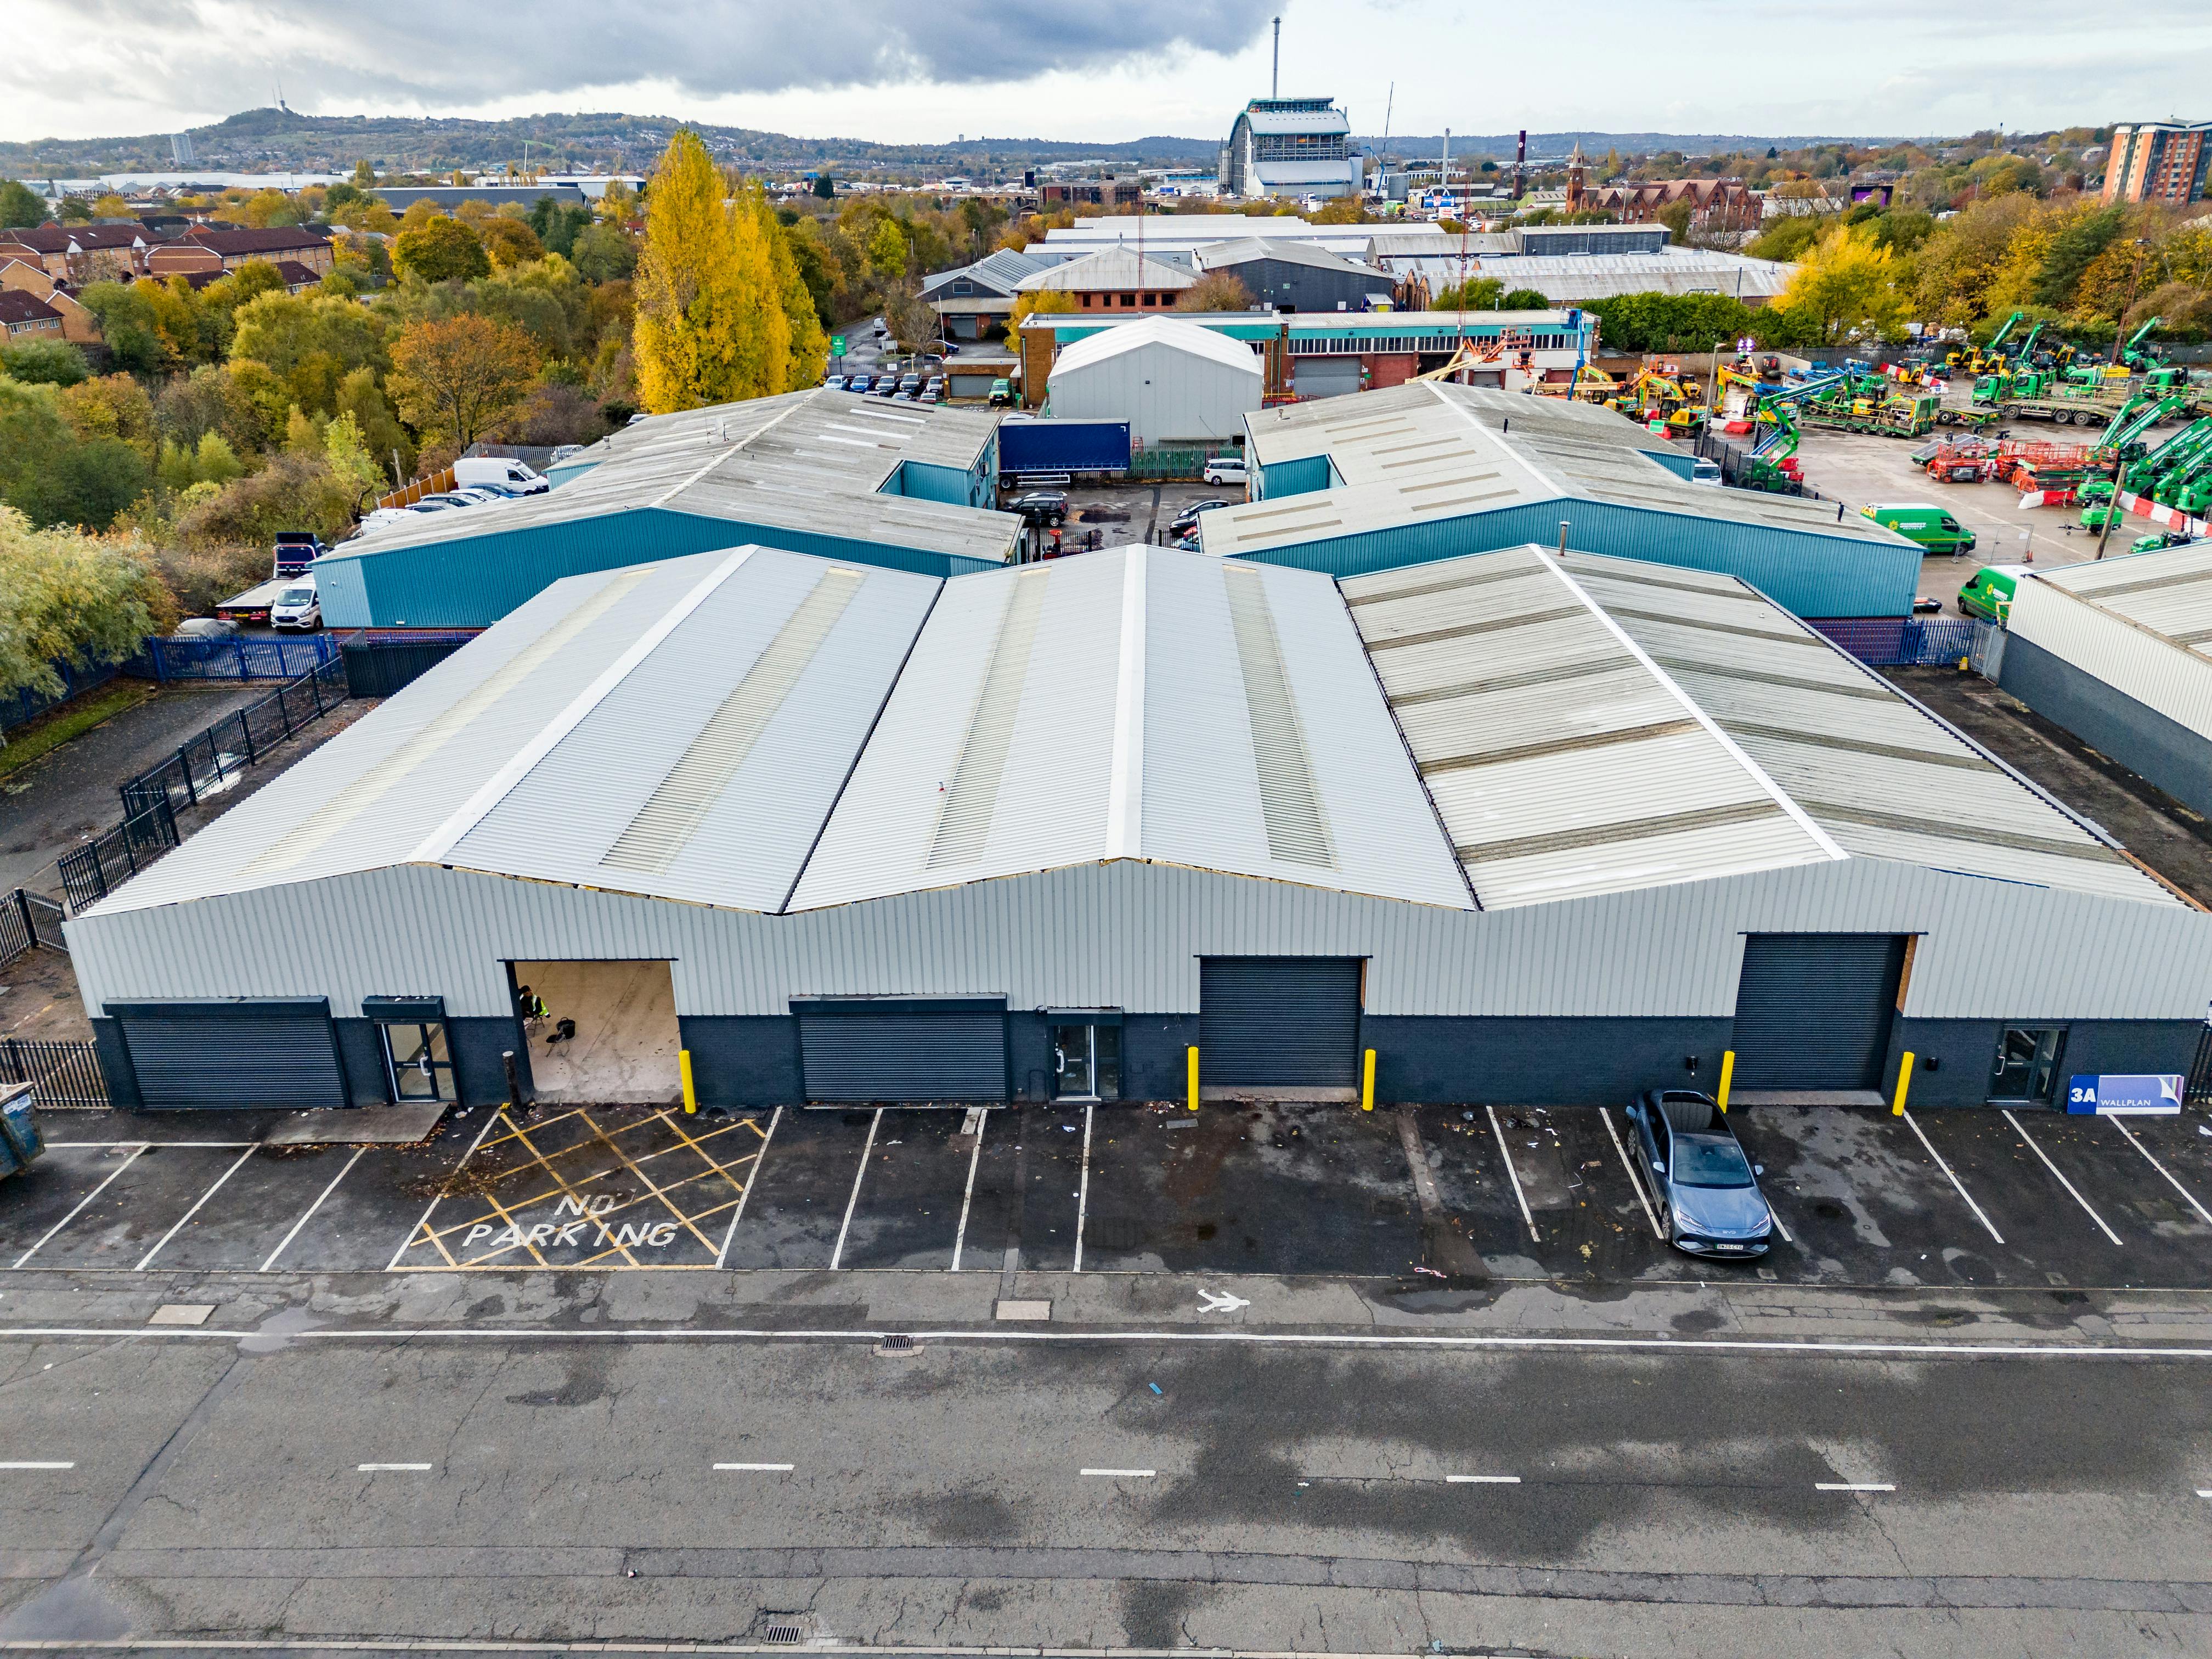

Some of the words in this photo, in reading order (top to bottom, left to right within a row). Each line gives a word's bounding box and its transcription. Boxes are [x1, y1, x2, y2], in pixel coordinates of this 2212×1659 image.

[2071, 1088, 2096, 1103] 3A
[554, 1194, 615, 1216] NO
[462, 1223, 679, 1247] PARKING
